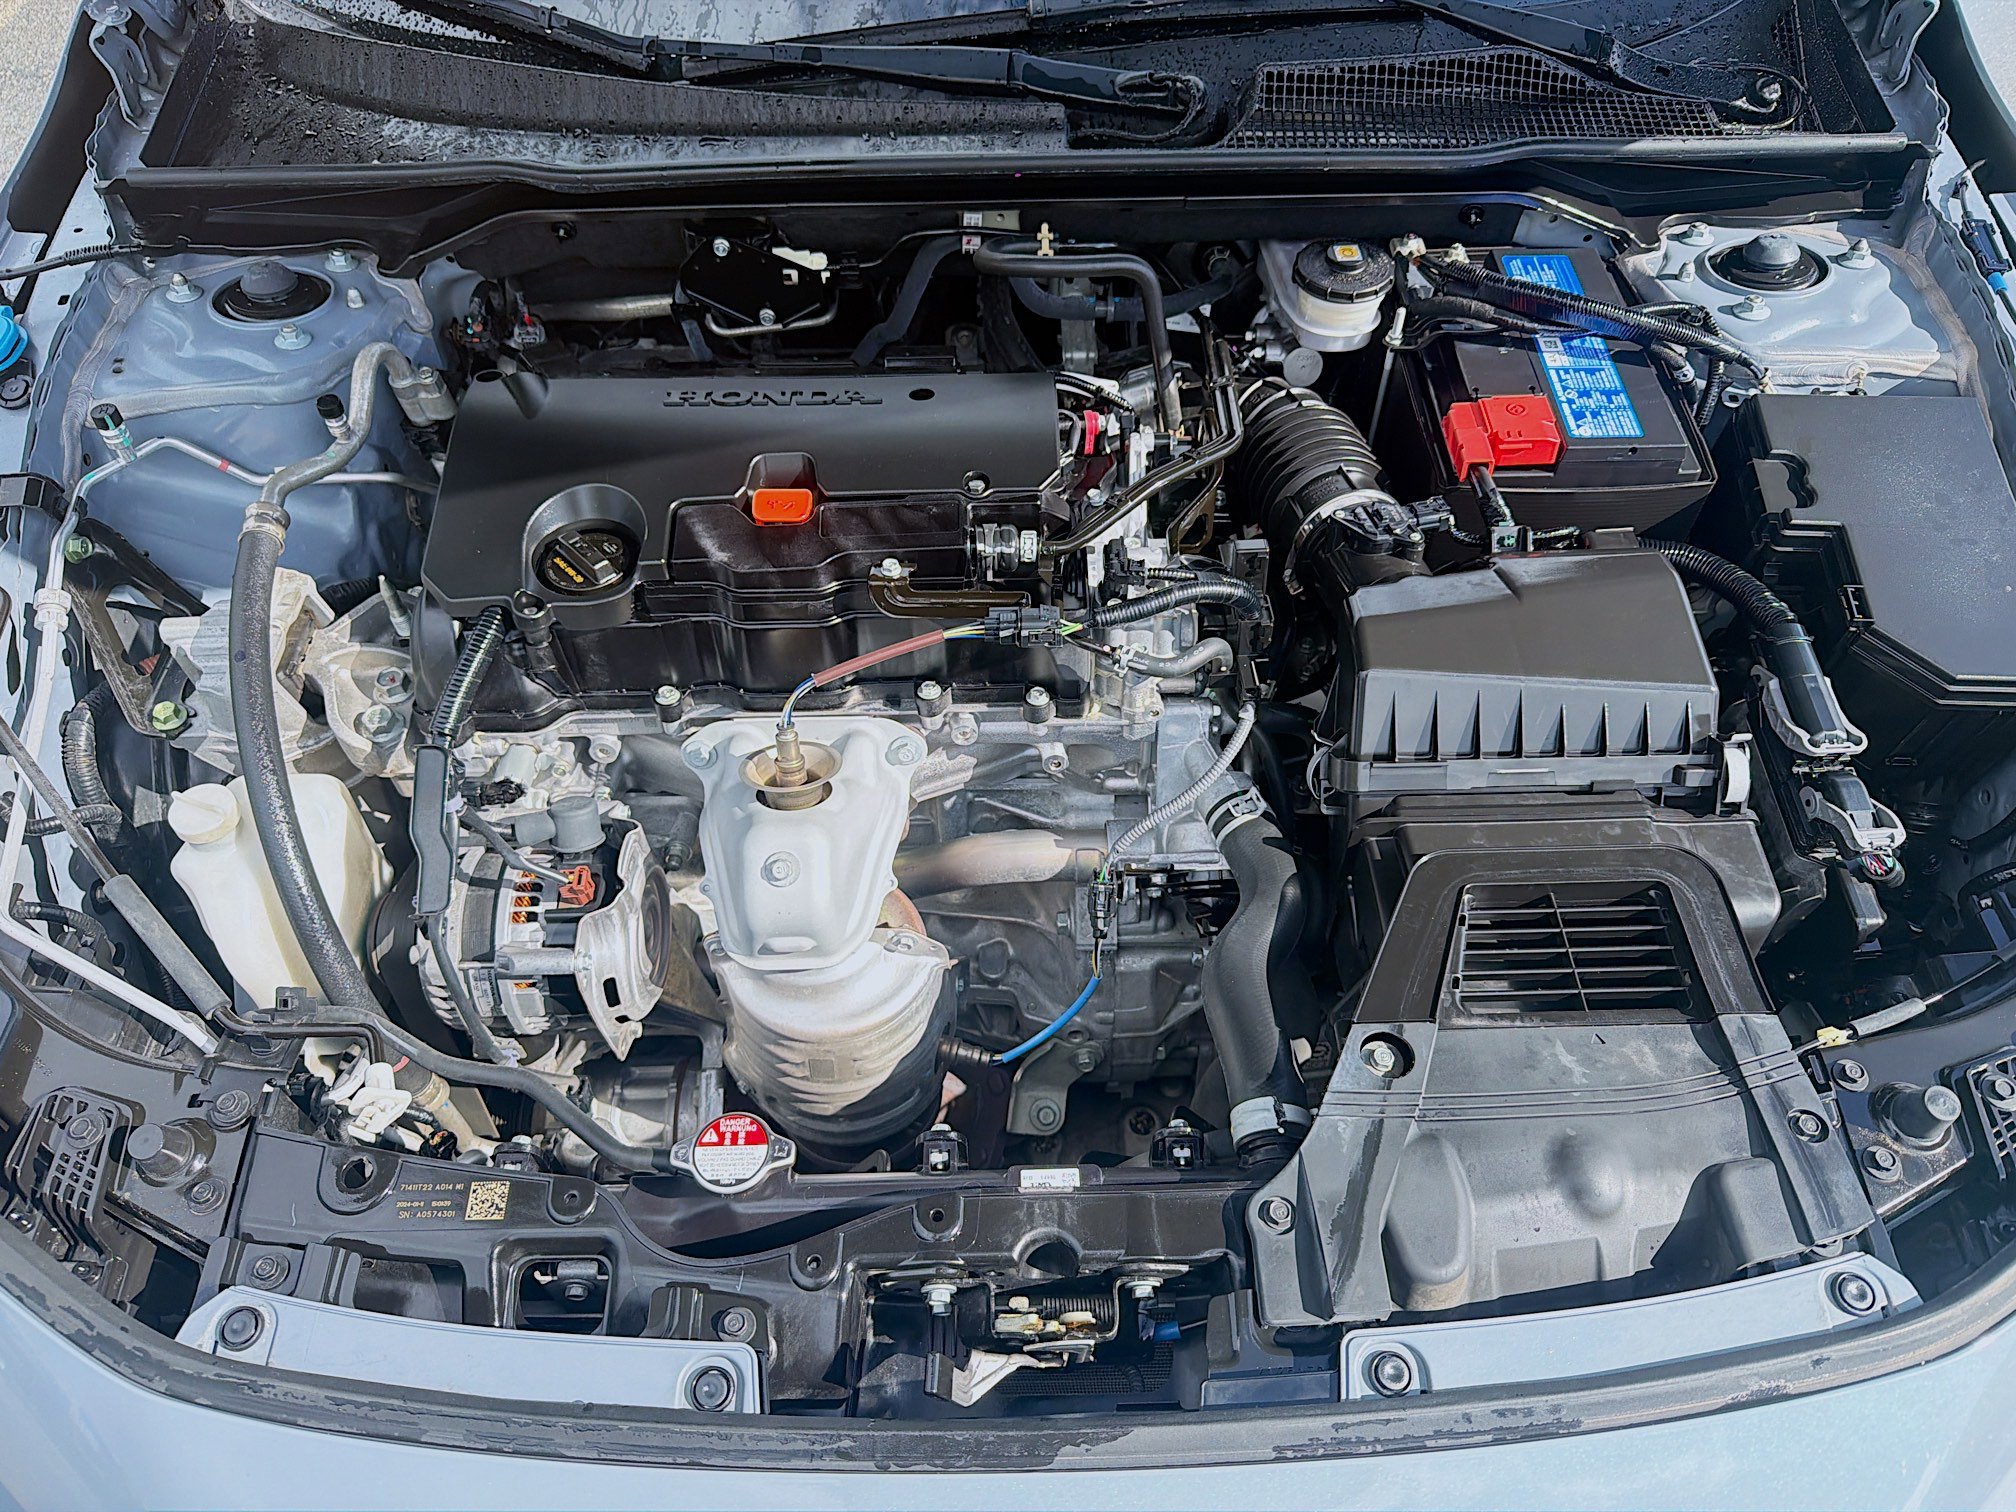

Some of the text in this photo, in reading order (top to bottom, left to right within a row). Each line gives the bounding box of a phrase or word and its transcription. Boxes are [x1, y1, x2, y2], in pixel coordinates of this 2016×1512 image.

[663, 391, 882, 407] HONDA
[720, 1118, 751, 1126] DANGER
[399, 1211, 413, 1219] SN:
